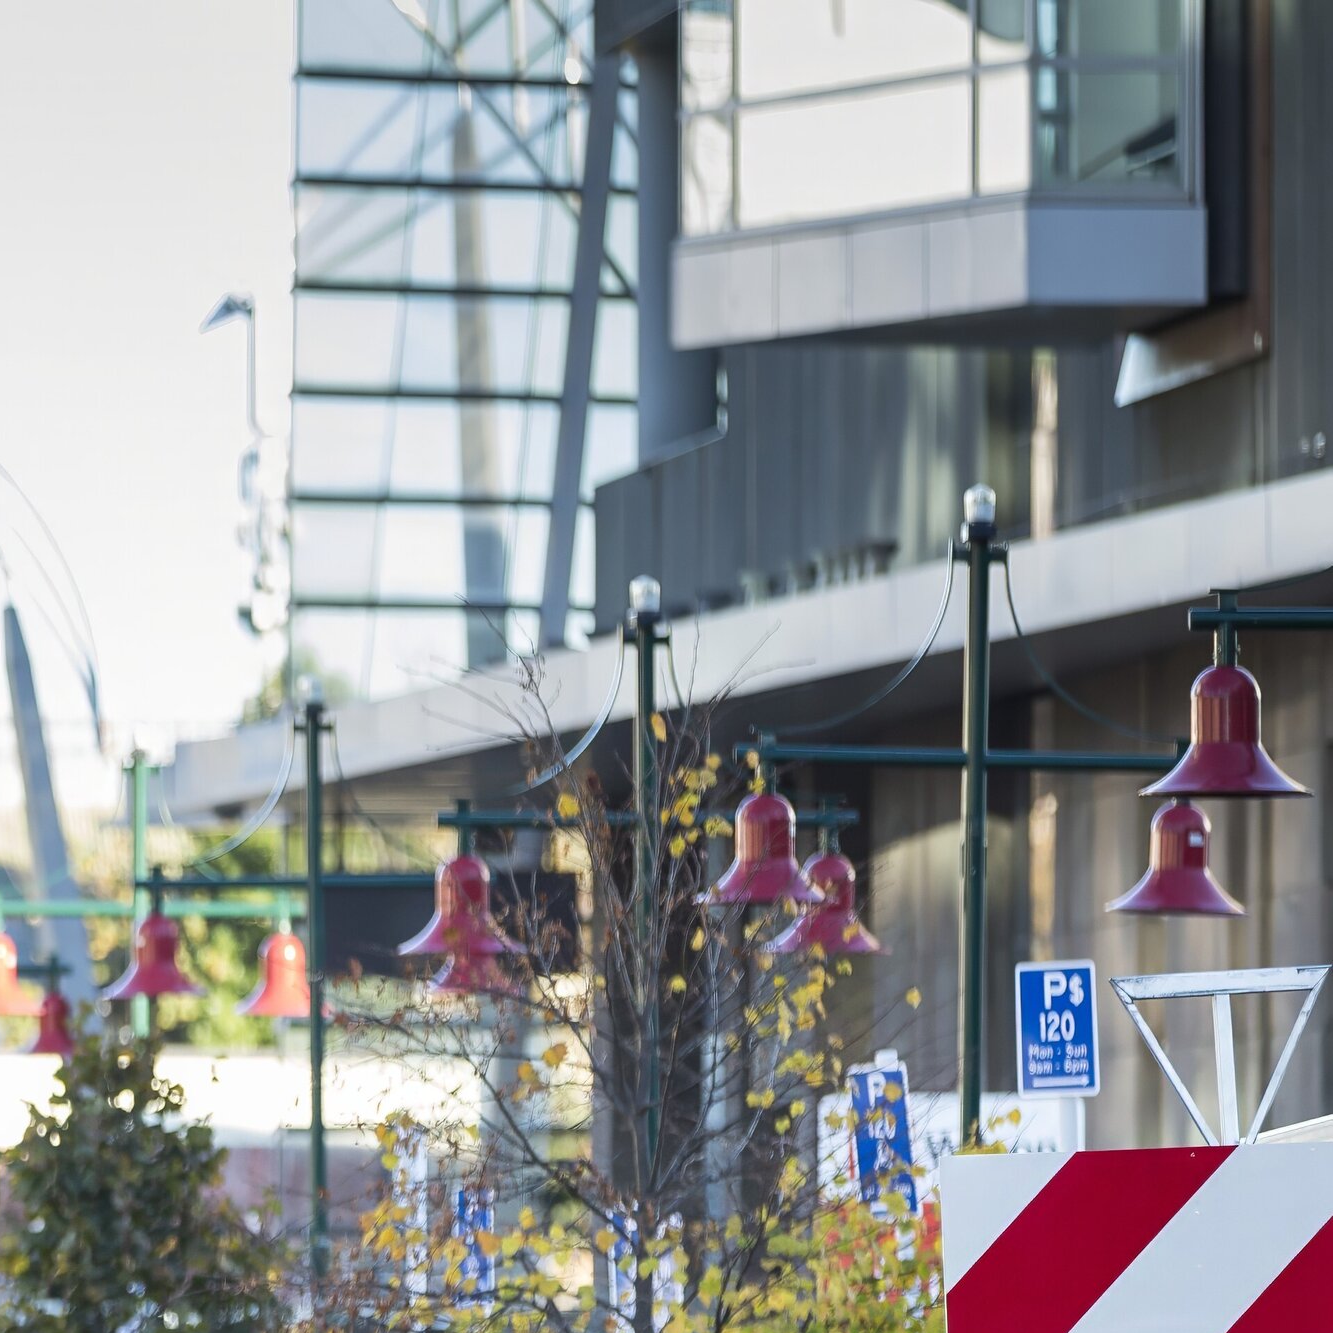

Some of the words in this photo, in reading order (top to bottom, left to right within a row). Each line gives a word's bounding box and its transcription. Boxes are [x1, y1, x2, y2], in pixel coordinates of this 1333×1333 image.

[1038, 1009, 1076, 1042] 120
[1028, 1044, 1054, 1061] Mon
[1064, 1042, 1088, 1060] Sun
